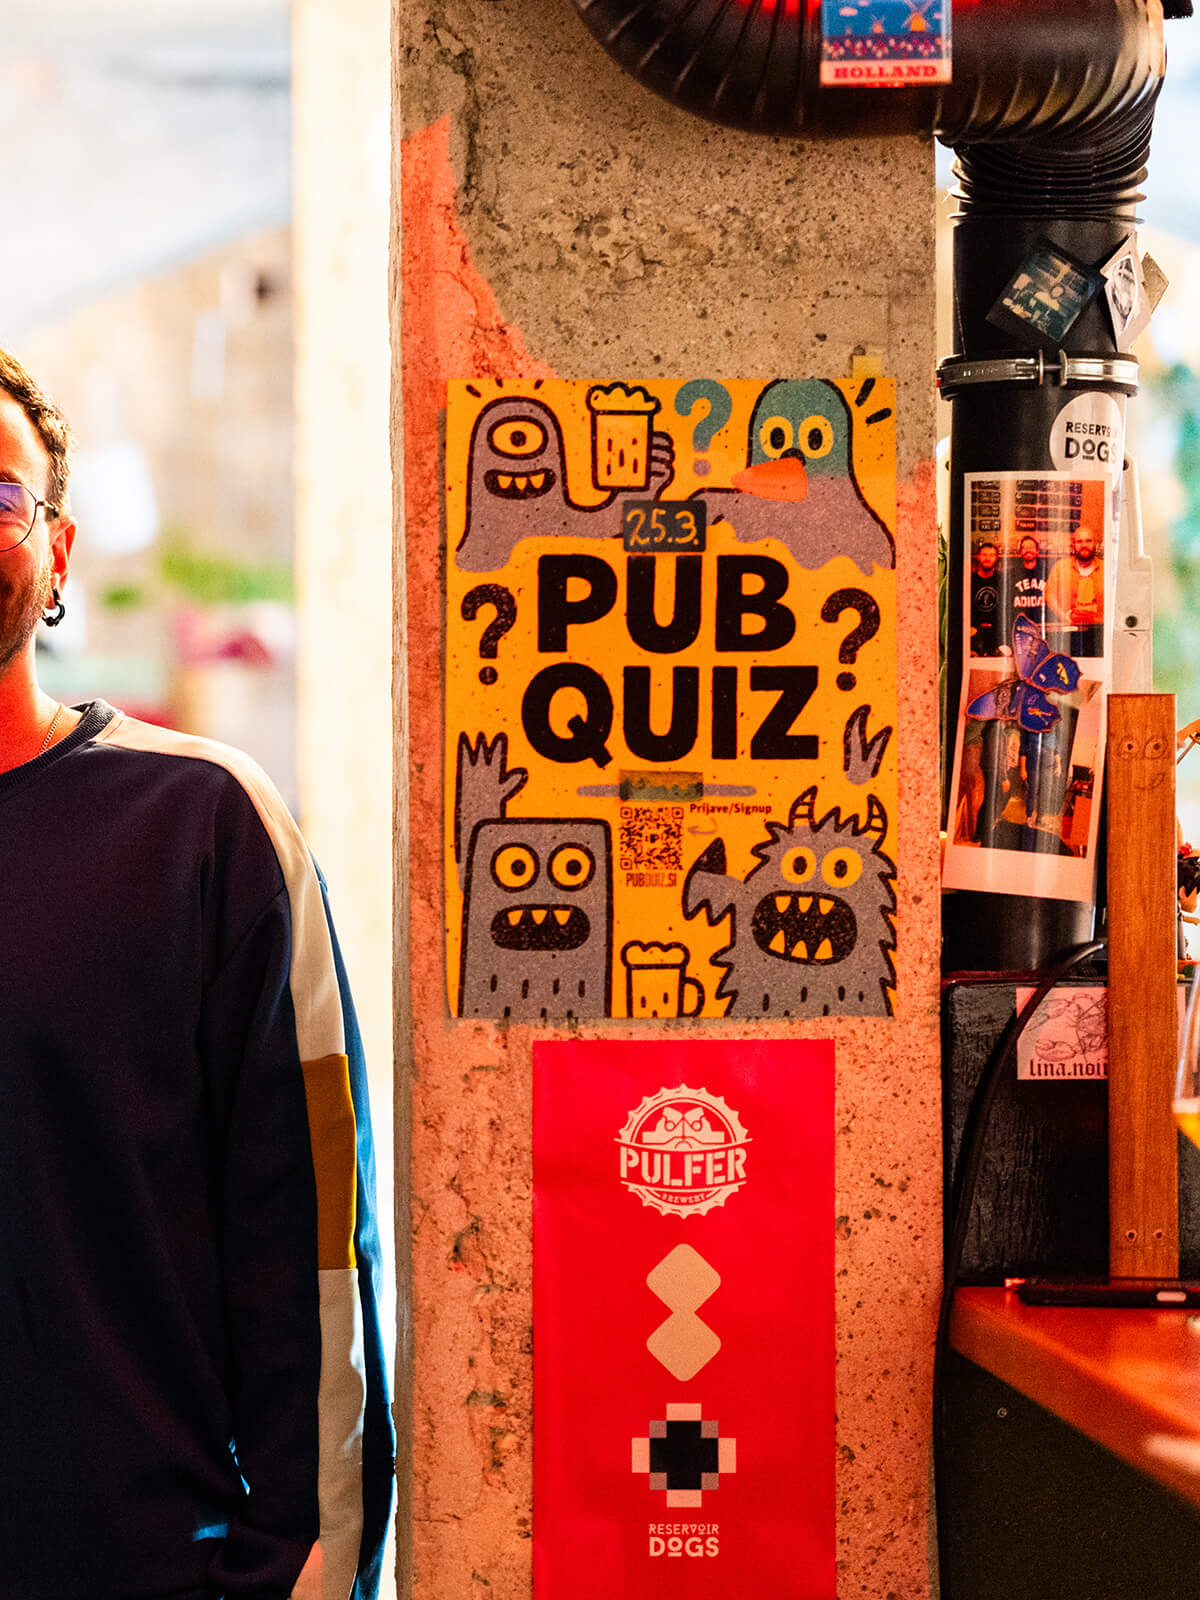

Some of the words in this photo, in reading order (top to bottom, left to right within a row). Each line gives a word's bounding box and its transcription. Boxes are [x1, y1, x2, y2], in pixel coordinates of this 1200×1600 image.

[833, 65, 937, 79] HOLLAND
[1065, 421, 1118, 438] RESERVO
[626, 508, 699, 547] 25.3.
[537, 553, 797, 655] PUB
[1013, 595, 1043, 608] ADIDA
[520, 662, 820, 768] QUIZ
[690, 803, 772, 816] Prijave/Signup
[619, 1146, 747, 1187] PULFER
[662, 1193, 706, 1204] BREWERY
[648, 1523, 719, 1535] RESERVOIR
[649, 1536, 720, 1558] DOGS
